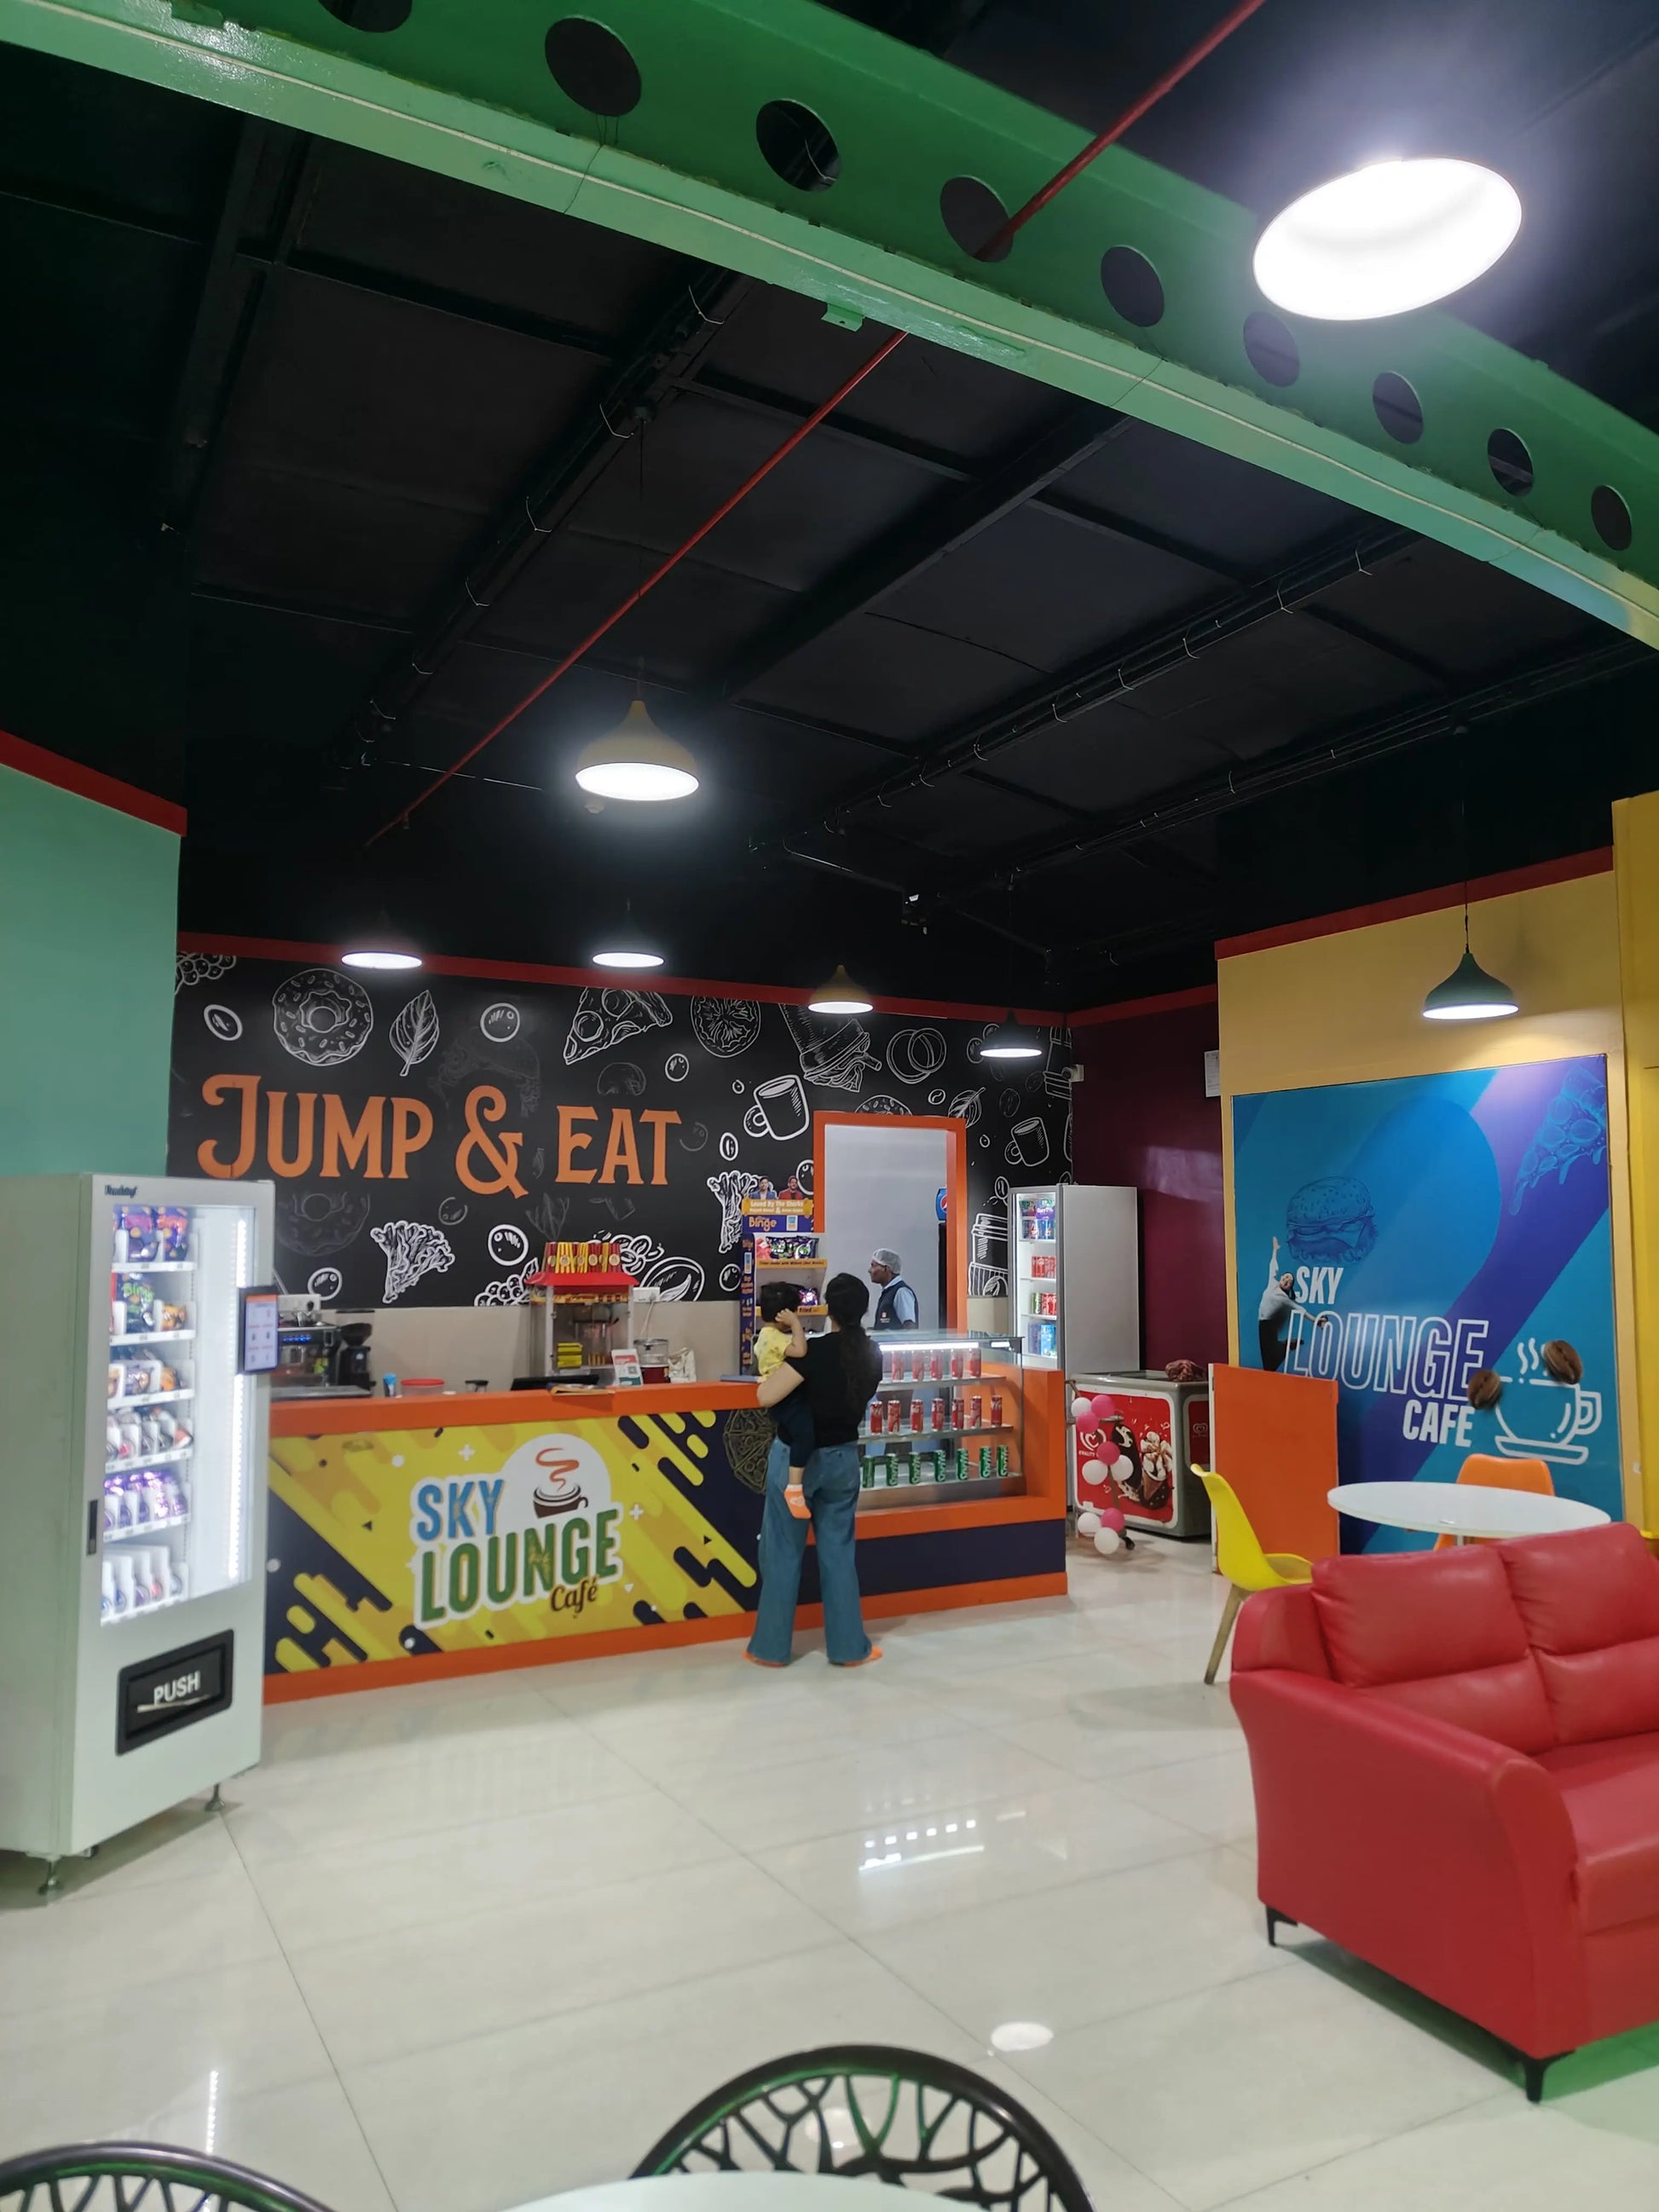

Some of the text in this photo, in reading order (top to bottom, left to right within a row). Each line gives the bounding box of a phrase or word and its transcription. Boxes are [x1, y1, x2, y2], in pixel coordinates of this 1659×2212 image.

[197, 1074, 681, 1198] JUMP & EAT
[749, 1216, 777, 1232] Binge
[1295, 1266, 1344, 1304] SKY
[1284, 1309, 1489, 1401] LOUNGE
[1402, 1400, 1476, 1447] CAFE
[417, 1479, 505, 1542] SKY
[420, 1509, 619, 1622] LOUNGE
[551, 1578, 598, 1614] Café
[153, 1671, 201, 1706] PUSH
